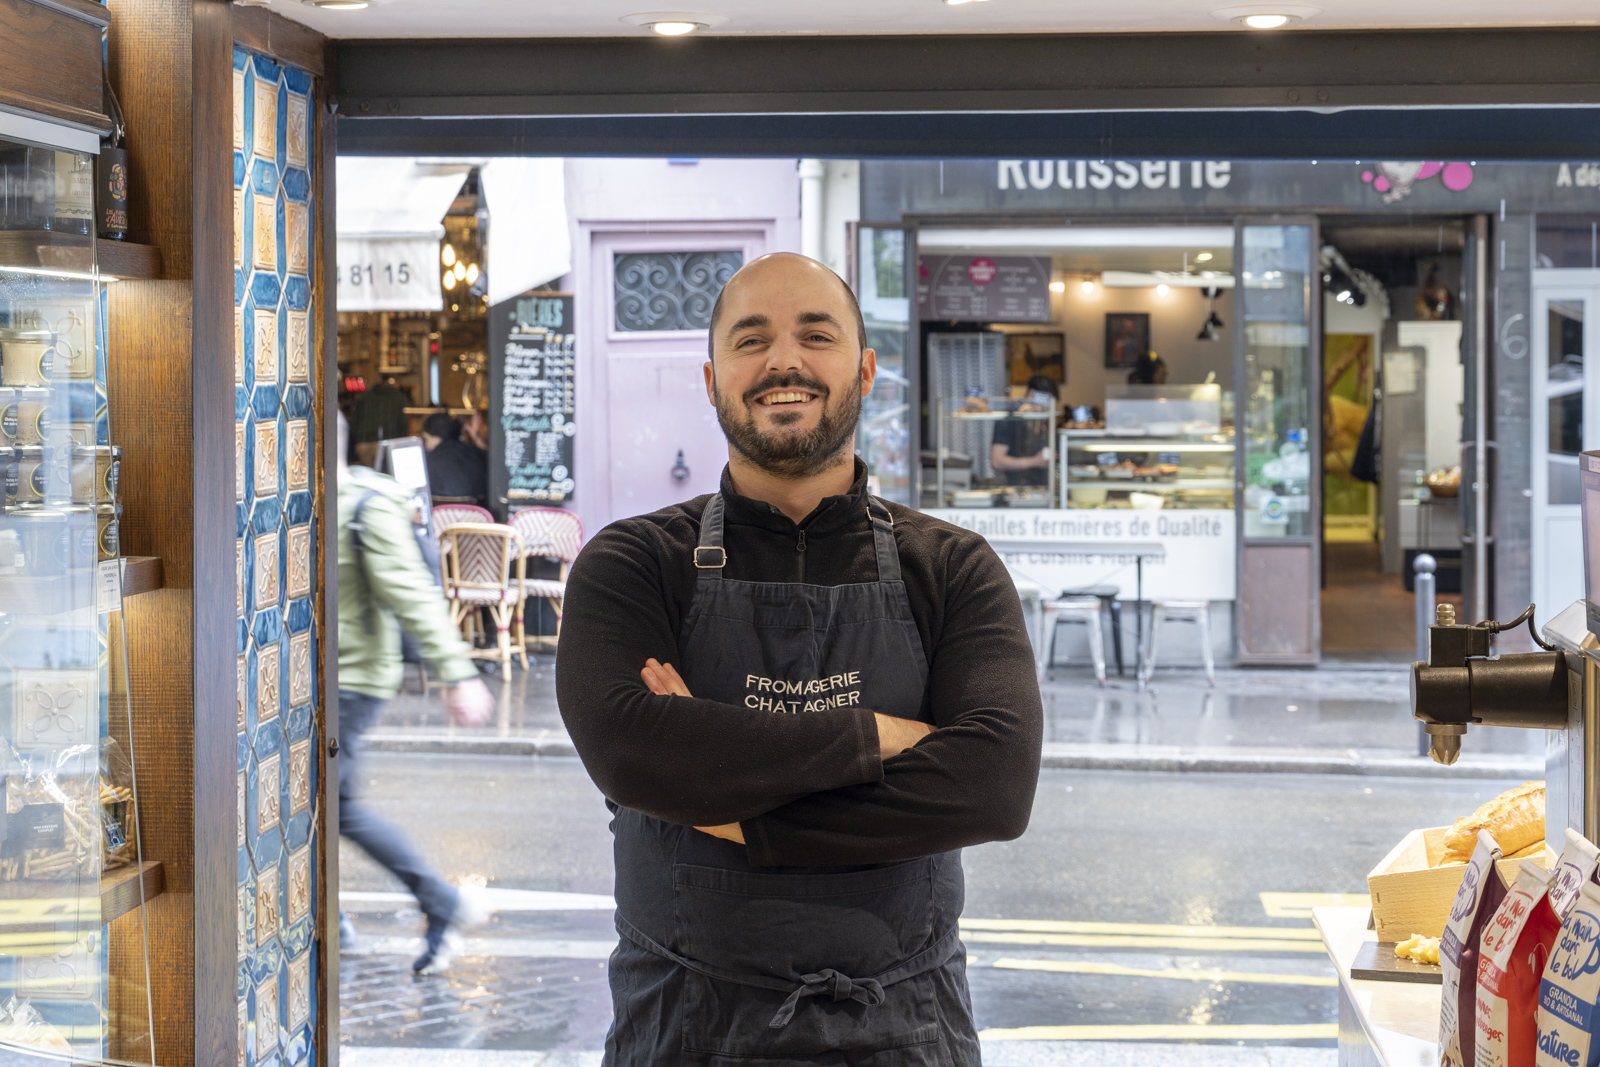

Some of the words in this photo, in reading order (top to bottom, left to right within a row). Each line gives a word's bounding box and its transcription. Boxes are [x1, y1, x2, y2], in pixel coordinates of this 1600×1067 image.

[350, 264, 374, 287] 81
[384, 262, 410, 285] 15
[1500, 313, 1529, 361] 6
[1033, 514, 1123, 537] fermières
[1129, 515, 1151, 537] de
[1156, 515, 1222, 537] Qualité
[745, 671, 861, 695] FROMAGERIE
[1483, 922, 1494, 947] le
[1571, 917, 1593, 943] main
[1550, 947, 1560, 974] le
[1561, 953, 1579, 980] bol
[1548, 986, 1577, 1011] GRANOLA
[1555, 1003, 1584, 1025] ARTISANAL
